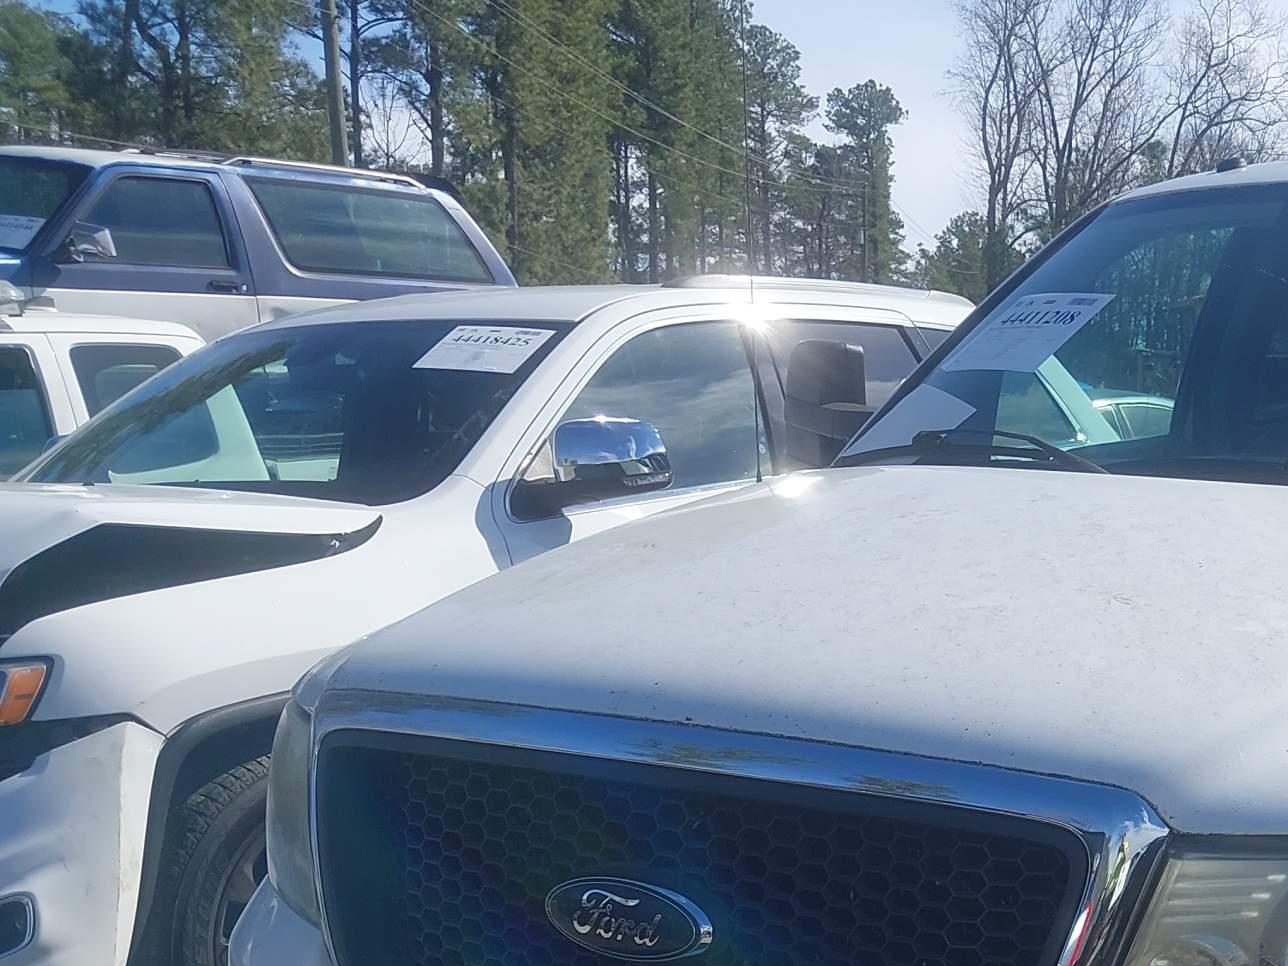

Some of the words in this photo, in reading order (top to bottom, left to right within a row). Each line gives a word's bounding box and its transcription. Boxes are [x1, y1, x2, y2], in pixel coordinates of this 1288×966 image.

[1001, 310, 1082, 326] 44411208
[451, 334, 533, 347] 44418425
[573, 889, 662, 947] Ford
